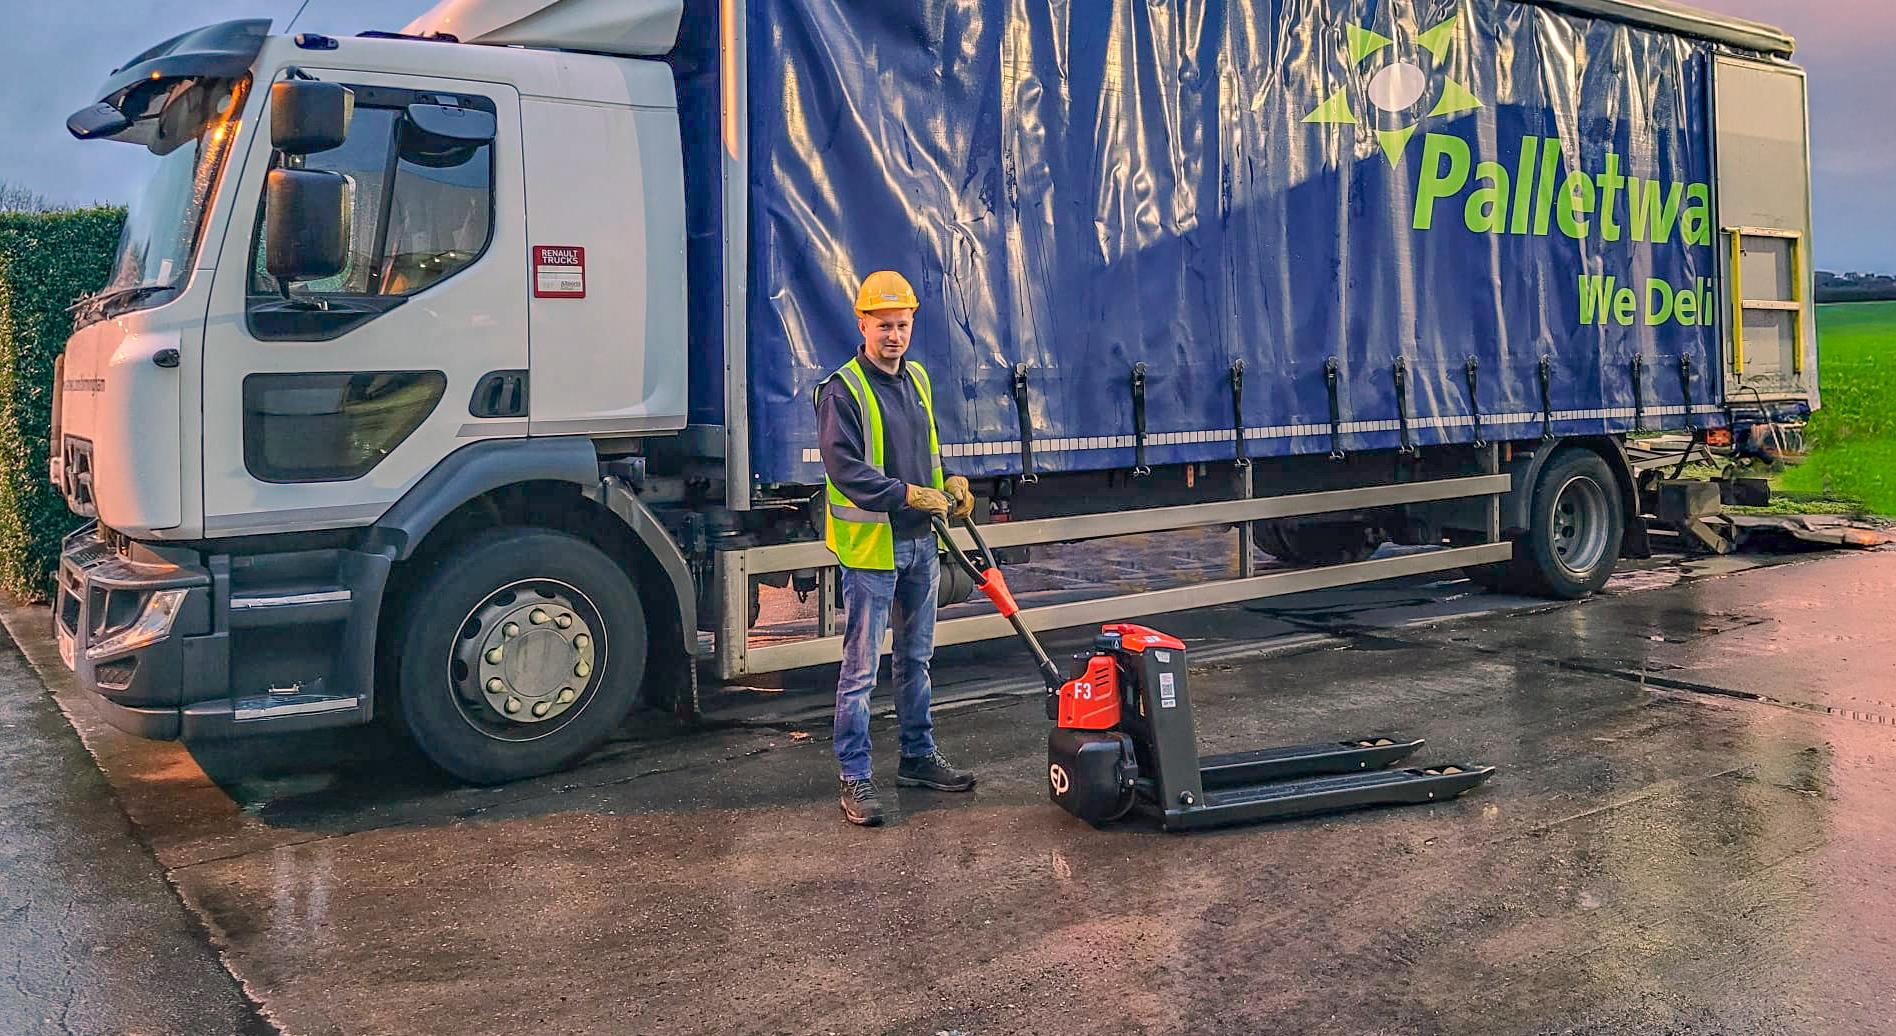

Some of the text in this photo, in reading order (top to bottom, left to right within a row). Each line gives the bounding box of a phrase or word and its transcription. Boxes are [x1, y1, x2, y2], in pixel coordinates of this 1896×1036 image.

[1412, 132, 1711, 246] Palletwa
[541, 249, 578, 257] RENAULT
[542, 256, 579, 264] TRUCKS
[1578, 274, 1712, 326] We Deli
[1073, 682, 1092, 700] F3
